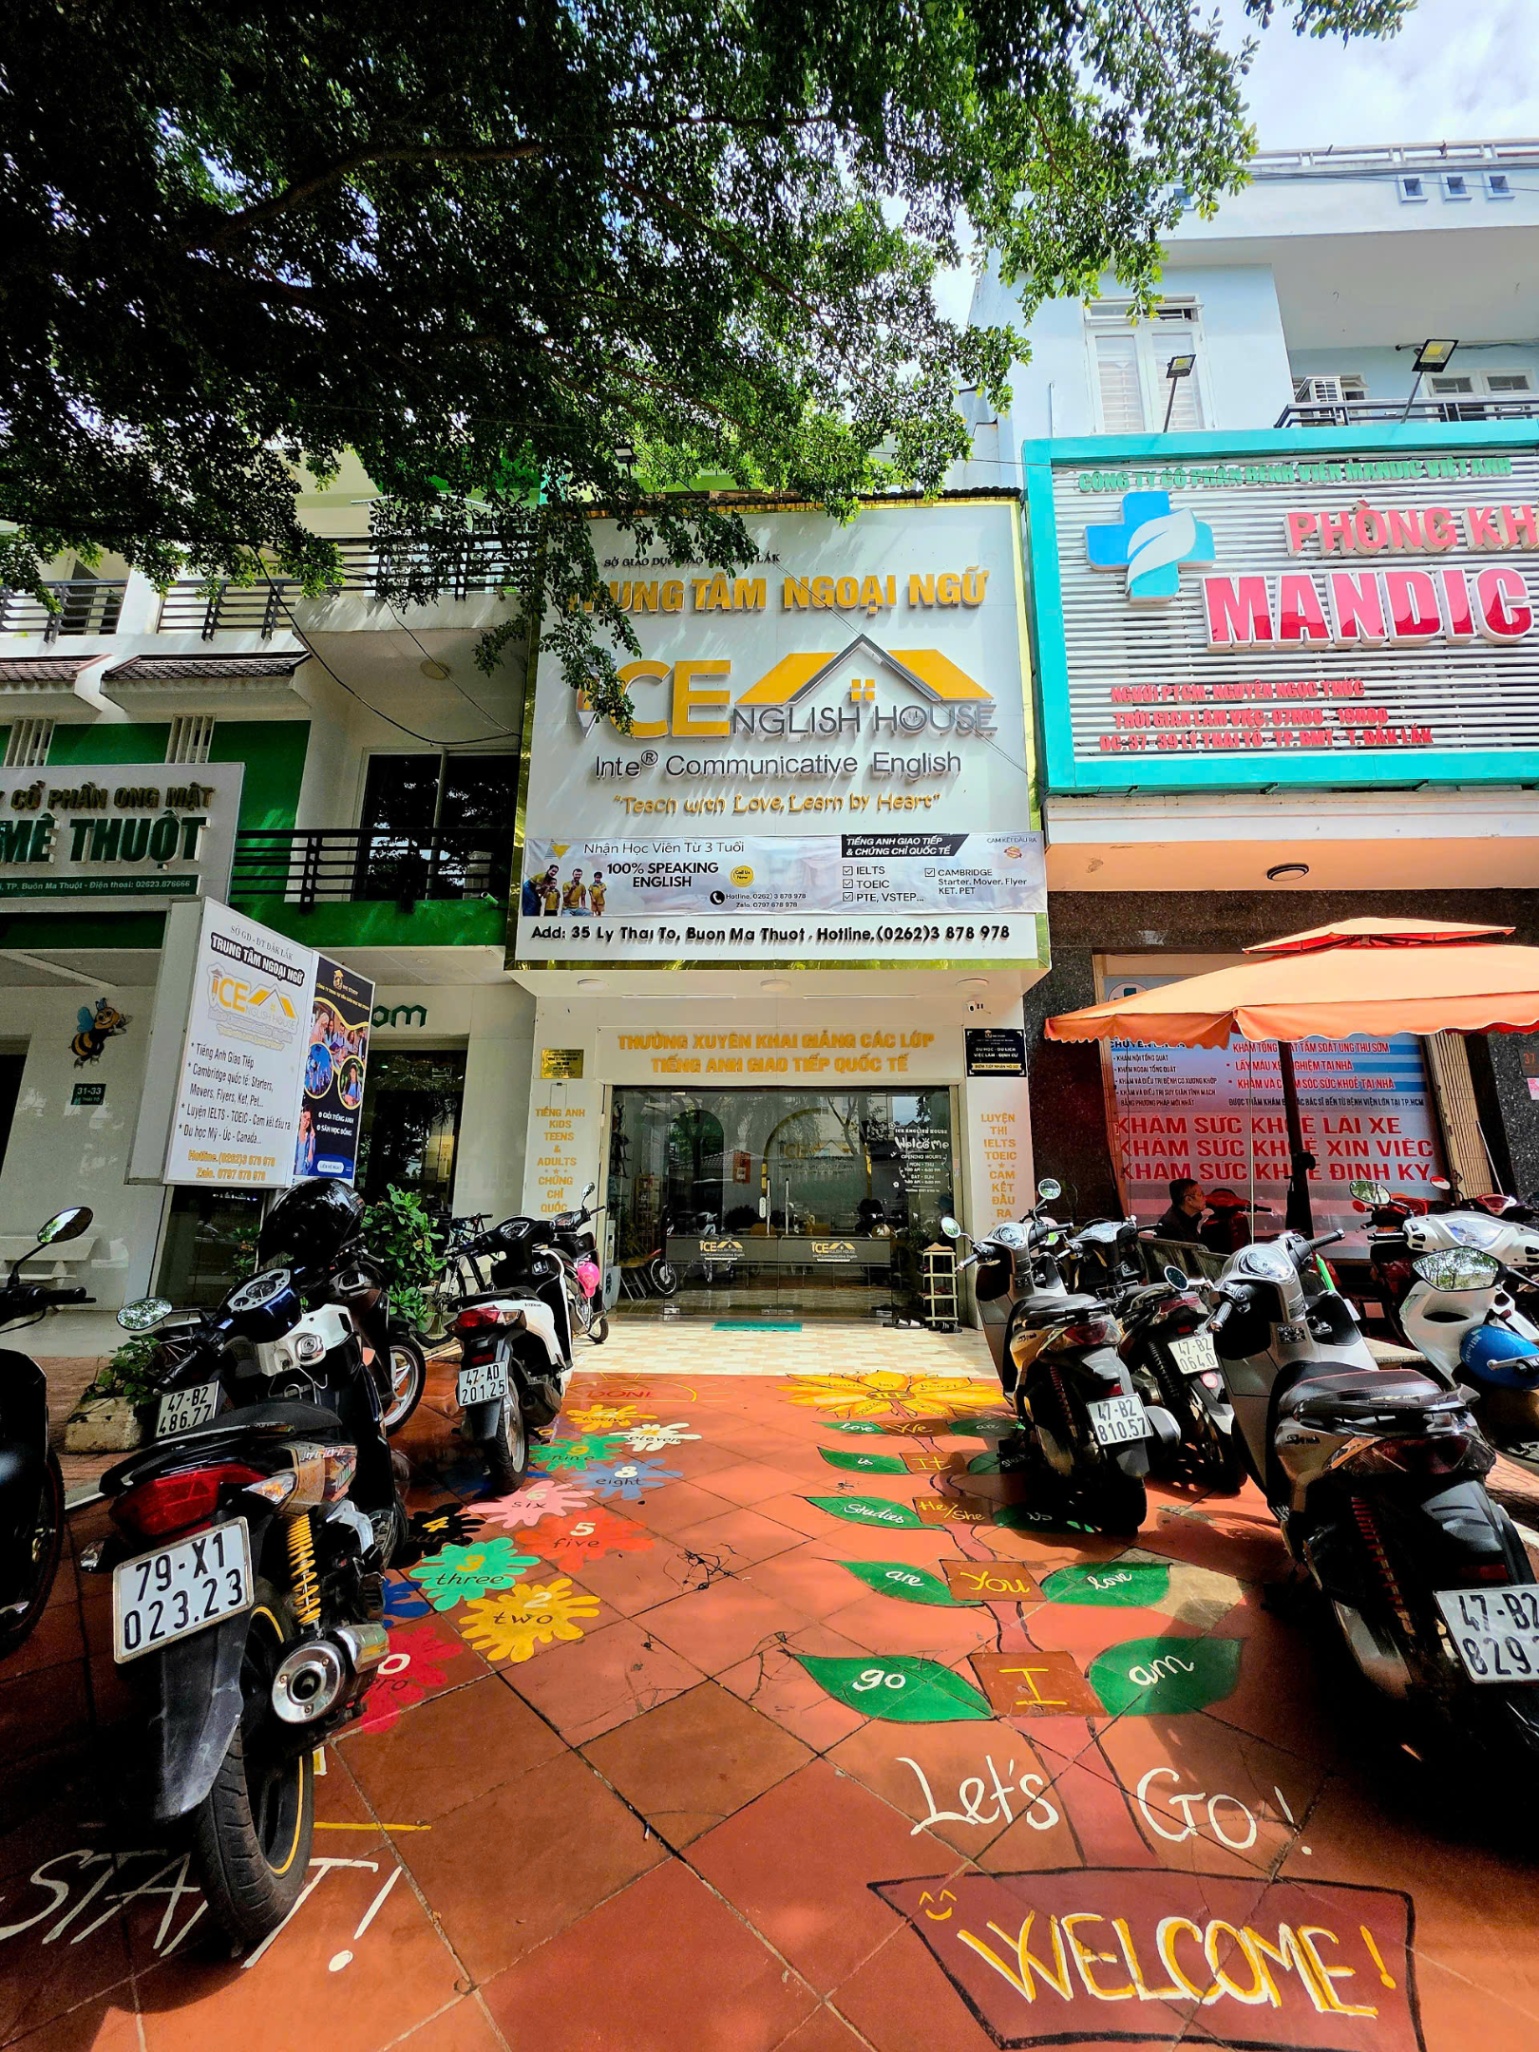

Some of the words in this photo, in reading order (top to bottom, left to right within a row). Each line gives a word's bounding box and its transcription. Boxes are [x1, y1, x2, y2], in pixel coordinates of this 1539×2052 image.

[1284, 499, 1458, 557] PHÒNG
[1463, 505, 1539, 551] KH
[568, 580, 685, 613] UNG
[691, 572, 767, 611] TÂM
[784, 574, 897, 614] NGOẠI
[909, 565, 990, 606] NGỮ
[1201, 567, 1533, 649] MANDIC
[874, 703, 999, 733] HOUSE
[666, 753, 858, 778] Communicative
[873, 751, 962, 779] English
[10, 780, 46, 810] CỔ
[47, 781, 109, 809] PHẦN
[114, 787, 161, 808] ONG
[165, 782, 216, 811] MẬT
[789, 794, 844, 813] Learn
[850, 793, 870, 813] by
[70, 810, 209, 871] THUỘT
[584, 843, 618, 854] Nhận
[622, 843, 649, 856] Học
[652, 842, 681, 854] Viên
[705, 842, 713, 852] 3
[876, 837, 897, 845] ANH
[897, 836, 920, 845] GIAO
[846, 848, 853, 856] &
[607, 863, 645, 875] 100%
[647, 862, 719, 875] SPEAKING
[856, 866, 886, 876] IELTS
[938, 868, 993, 877] CAMBRIDGE
[632, 876, 692, 888] ENGLISH
[856, 880, 890, 889] TOEIC
[531, 926, 566, 939] Add:
[571, 925, 591, 939] 35
[597, 926, 614, 943] Ly
[686, 926, 726, 940] Buon
[730, 927, 755, 940] Ma
[760, 927, 805, 941] Thuot
[946, 925, 975, 940] 878
[980, 925, 1010, 940] 978
[211, 933, 242, 957] TRUNG
[243, 946, 261, 968] TÂM
[262, 957, 287, 981] NGOẠI
[618, 1030, 688, 1050] THƯỜNG
[692, 1031, 751, 1049] XUYÊN
[755, 1033, 798, 1049] KHAI
[859, 1032, 897, 1048] CÁC
[651, 1054, 701, 1073] TIẾNG
[706, 1057, 744, 1073] ANH
[747, 1057, 788, 1073] GIAO
[792, 1053, 830, 1072] TIẾP
[834, 1052, 882, 1073] QUỐC
[886, 1052, 910, 1072] TẾ
[192, 1063, 227, 1082] Cambridge
[565, 1108, 586, 1117] ANH
[981, 1112, 1016, 1125] LUYỆN
[549, 1120, 572, 1129] KIDS
[990, 1126, 1007, 1135] THI
[1194, 1115, 1243, 1134] SỨC
[1324, 1114, 1362, 1134] LÁI
[1368, 1117, 1402, 1134] XE
[544, 1132, 574, 1141] TEENS
[984, 1139, 1016, 1148] IELTS
[553, 1145, 561, 1153] &
[984, 1151, 1017, 1160] TOEIC
[1197, 1139, 1244, 1157] SỨC
[1327, 1139, 1374, 1157] XIN
[1378, 1137, 1433, 1158] VIỆC
[537, 1157, 577, 1166] ADULTS
[989, 1170, 1015, 1179] CAM
[1200, 1161, 1248, 1180] SỨC
[1329, 1162, 1390, 1181] ĐỊNH
[996, 1208, 1012, 1218] RA
[1178, 1338, 1212, 1356] 47-B2
[1180, 1353, 1216, 1371] 064.0
[466, 1364, 500, 1386] 47-AD
[167, 1386, 209, 1412] 47-B2
[462, 1380, 505, 1404] 201.25
[159, 1404, 212, 1434] 486.77
[1097, 1399, 1137, 1421] 47-B2
[839, 1423, 875, 1433] love
[885, 1423, 933, 1434] We
[1097, 1417, 1146, 1442] 810.57
[551, 1454, 596, 1462] nine
[570, 1445, 590, 1455] 9
[614, 1466, 638, 1478] 8
[911, 1456, 952, 1471] It
[595, 1477, 644, 1488] eight
[526, 1488, 549, 1500] 6
[511, 1500, 547, 1509] six
[918, 1500, 986, 1521] He/She
[843, 1503, 905, 1525] Studies
[422, 1516, 450, 1533] 4
[569, 1522, 596, 1536] 5
[552, 1537, 600, 1549] five
[135, 1532, 225, 1602] 79-X1
[456, 1554, 486, 1572] 3
[435, 1572, 505, 1586] three
[885, 1566, 925, 1588] are
[959, 1570, 1031, 1594] You
[1087, 1570, 1134, 1591] love
[124, 1568, 243, 1650] 023.23
[523, 1591, 553, 1609] 2
[493, 1608, 554, 1625] two
[1458, 1592, 1539, 1631] 47-B2
[377, 1653, 411, 1675] 0
[1462, 1636, 1539, 1675] 829.
[851, 1668, 906, 1692] go
[1128, 1655, 1195, 1687] am
[998, 1667, 1068, 1707] I
[0, 1848, 403, 1972] STAT!
[956, 1911, 1398, 2020] WELCOME!
